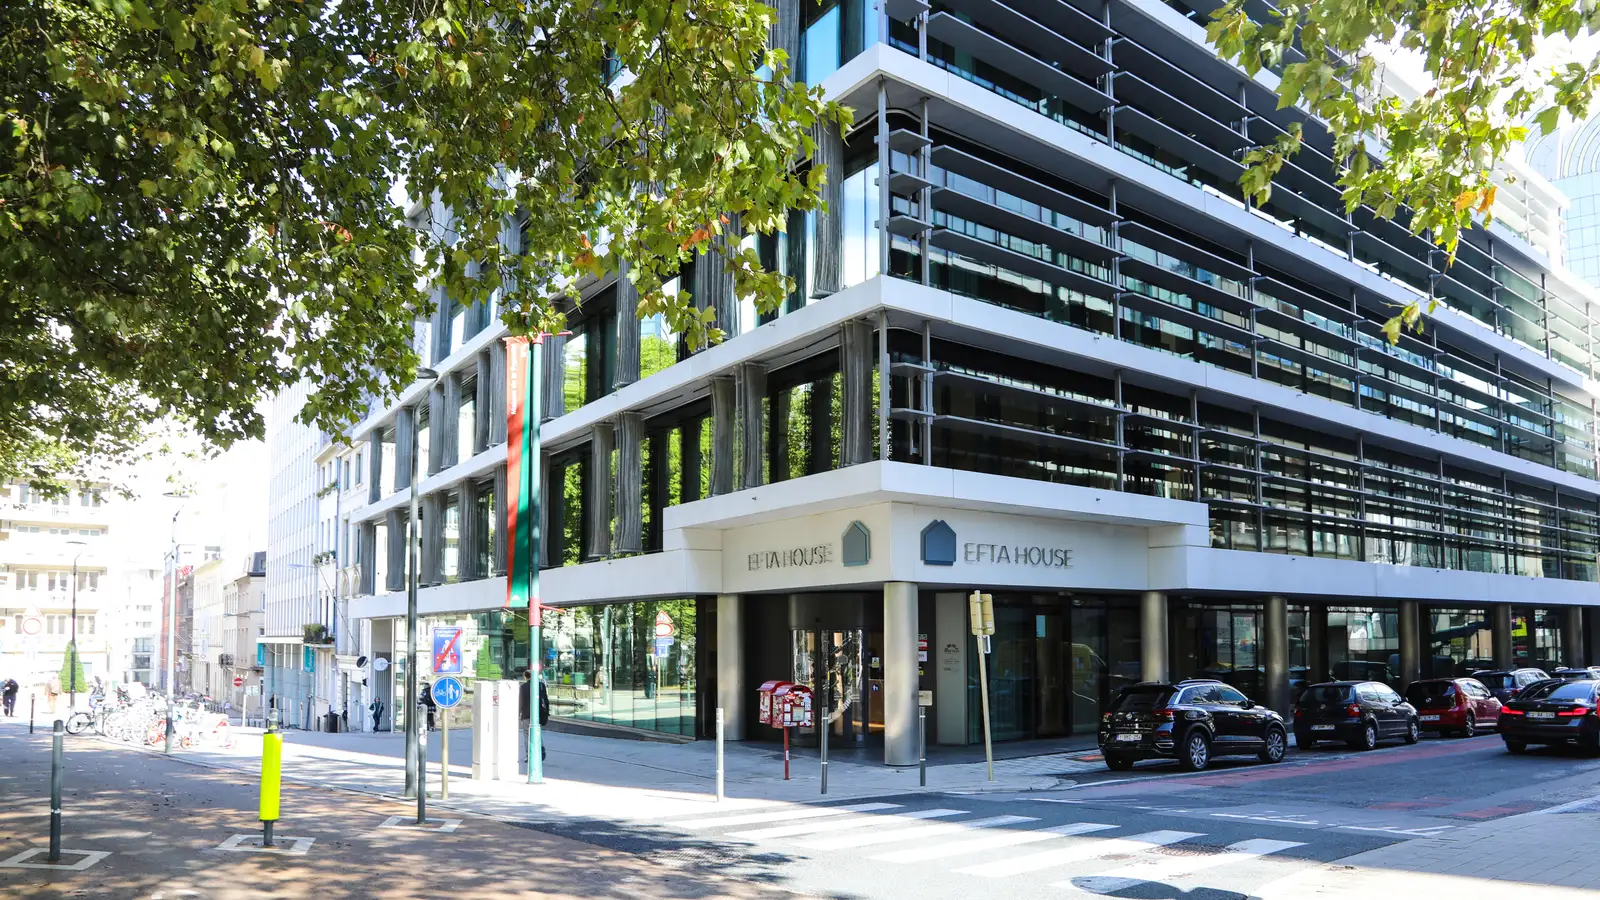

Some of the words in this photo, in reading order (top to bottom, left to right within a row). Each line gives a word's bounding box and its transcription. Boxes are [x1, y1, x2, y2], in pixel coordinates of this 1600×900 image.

[748, 551, 780, 571] EFTA
[782, 542, 833, 568] HOUSE
[963, 542, 1011, 564] EFTA
[1014, 545, 1074, 569] HOUSE
